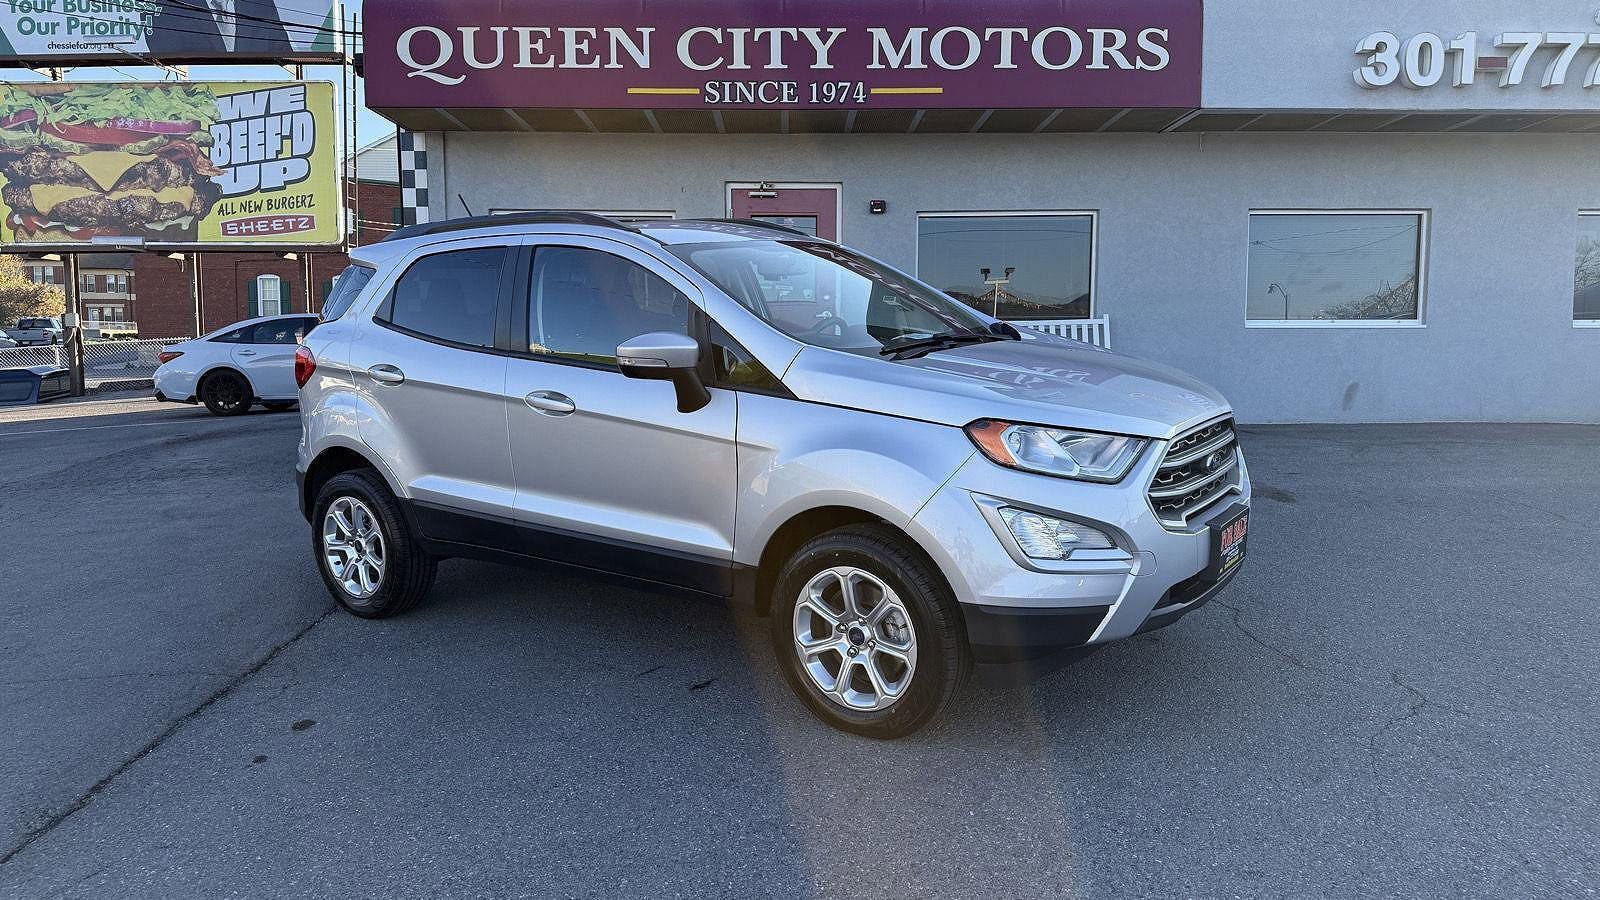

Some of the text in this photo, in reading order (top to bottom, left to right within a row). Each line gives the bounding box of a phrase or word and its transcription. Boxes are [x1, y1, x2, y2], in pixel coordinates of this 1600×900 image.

[8, 0, 162, 16] Your Business,
[17, 15, 154, 40] Our Priority!
[396, 25, 1170, 86] QUEEN CITY MOTORS
[216, 84, 306, 123] WE
[704, 80, 867, 104] SINCE 1974
[209, 111, 316, 168] BEEF'D
[211, 157, 311, 198] UP
[217, 193, 316, 216] ALL NEW BURGERZ
[226, 216, 311, 235] SHEETZ
